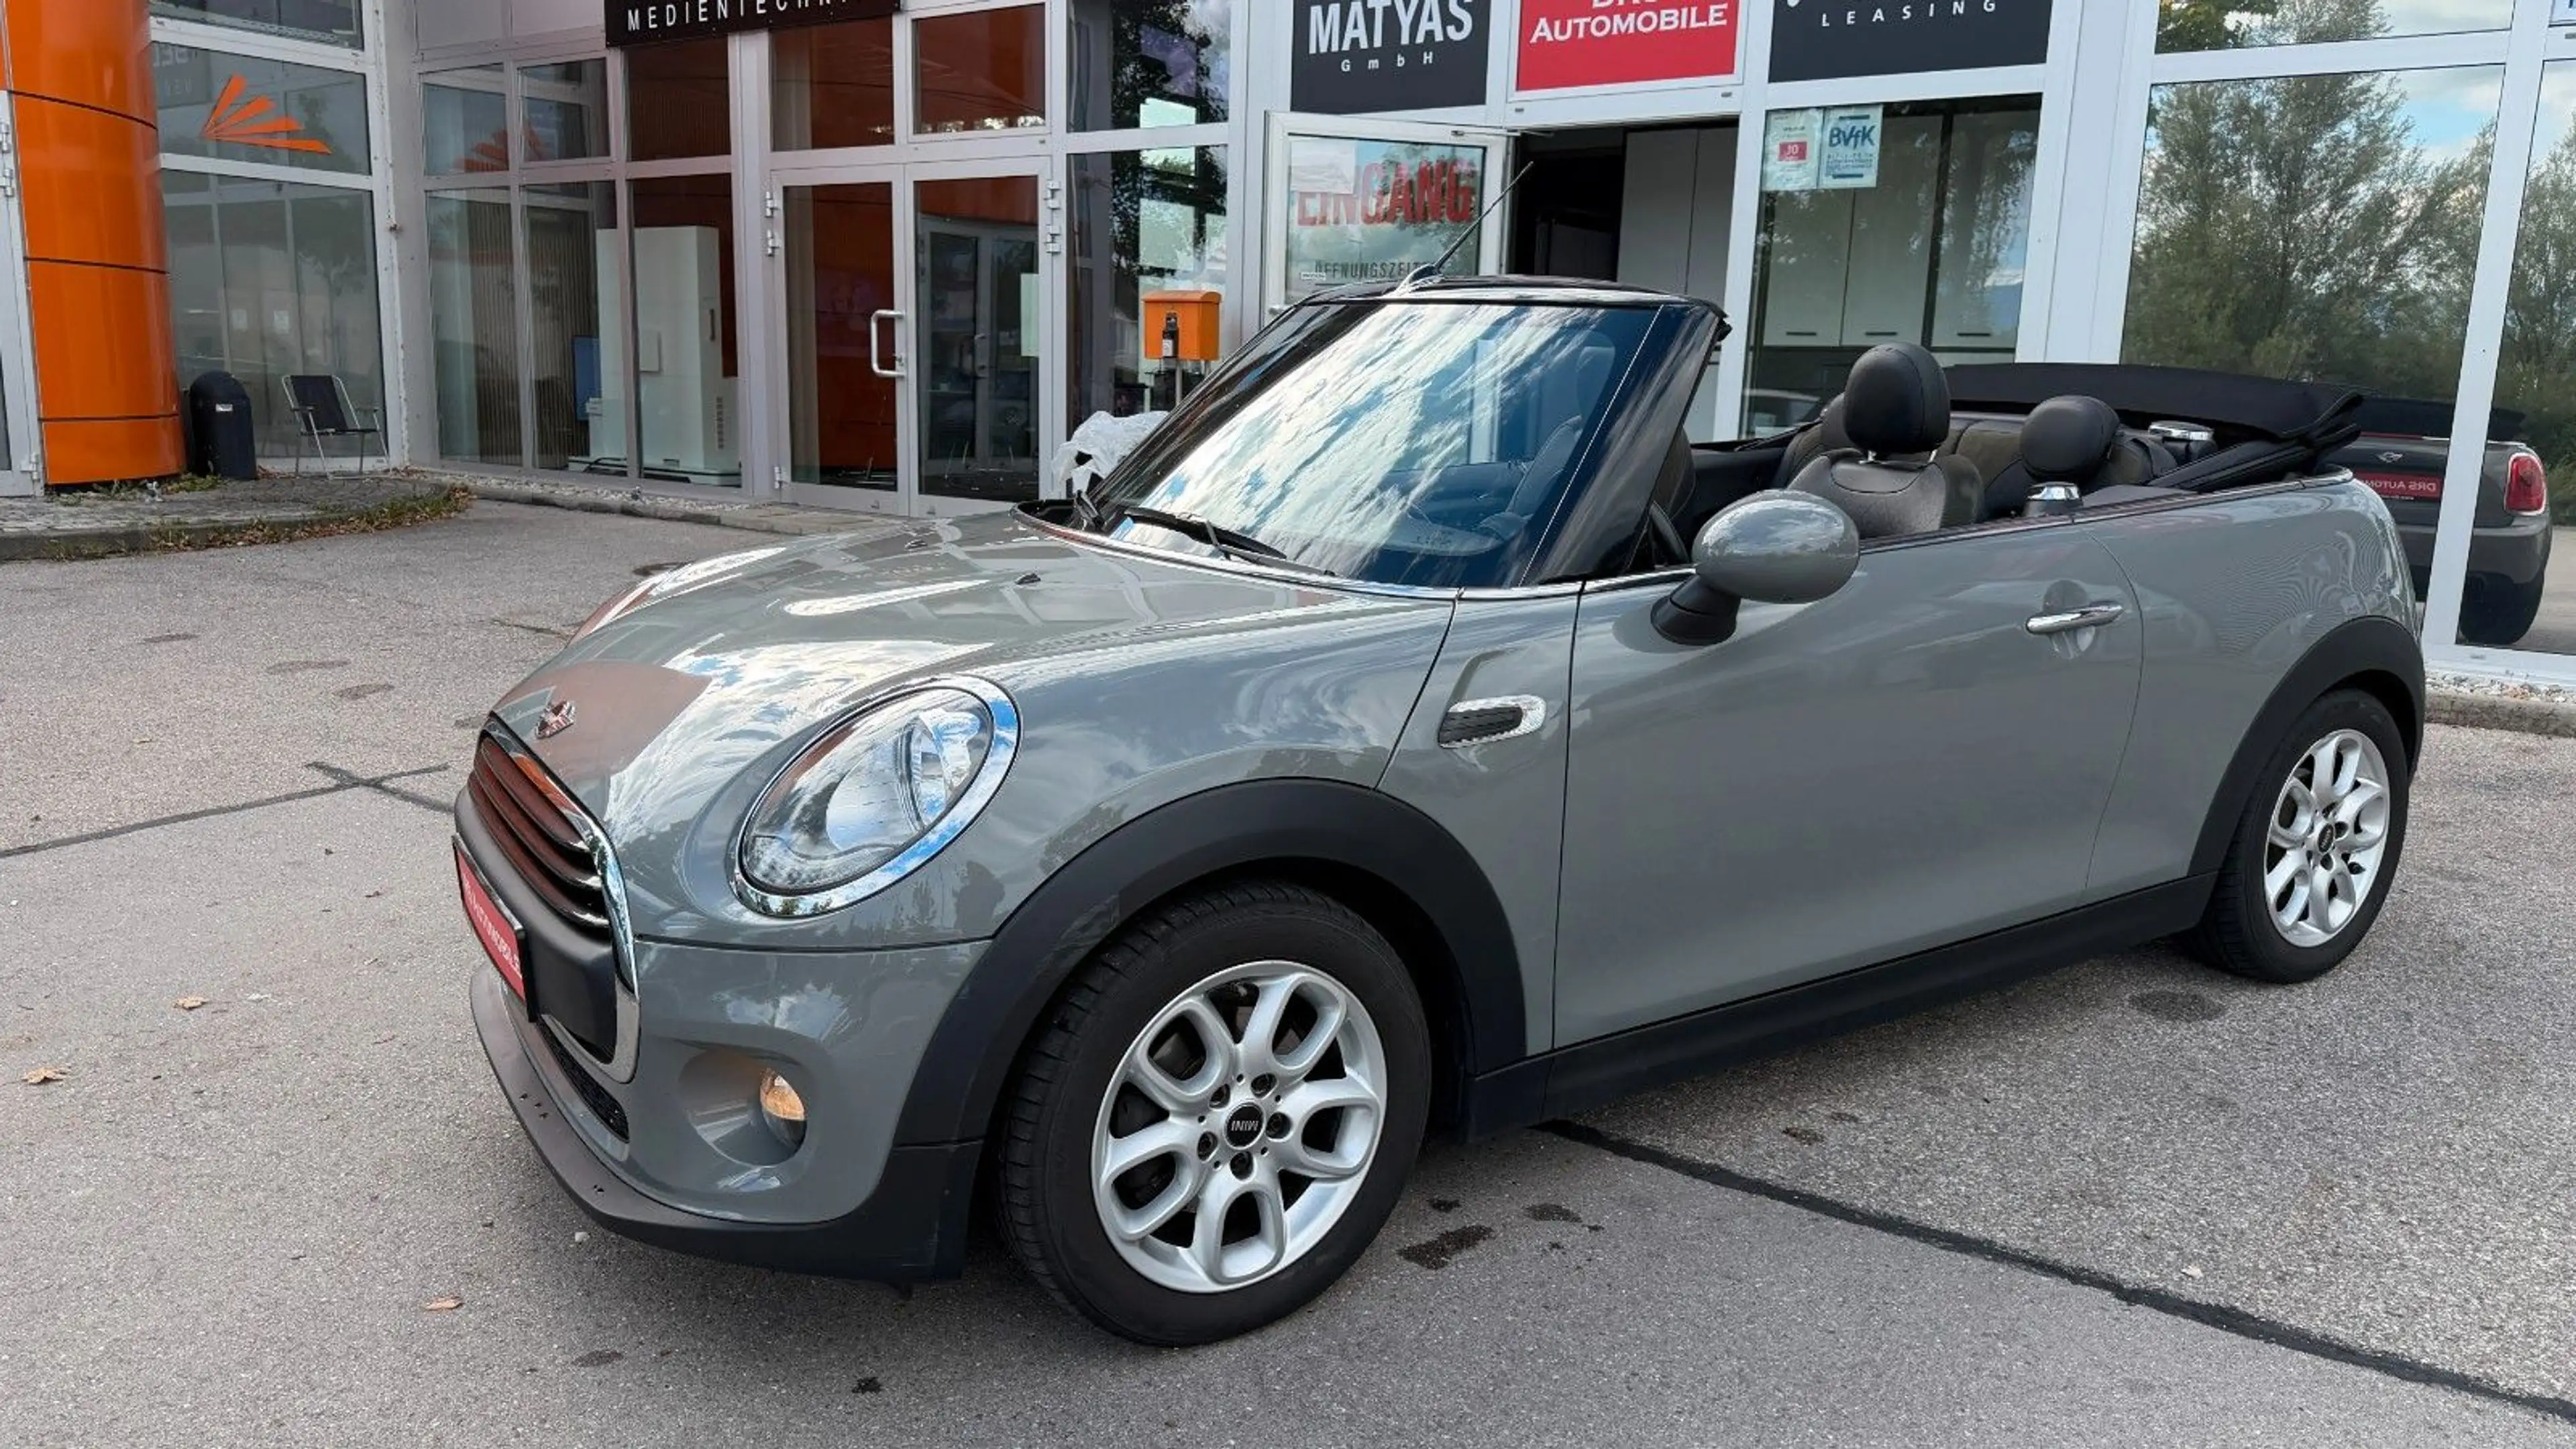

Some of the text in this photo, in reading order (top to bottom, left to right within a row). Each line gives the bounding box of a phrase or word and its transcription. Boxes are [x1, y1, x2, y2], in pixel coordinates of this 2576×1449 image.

[1309, 0, 1472, 54] MATYAS
[1529, 3, 1728, 44] AUTOMOBILE
[1821, 0, 1996, 27] LEASING
